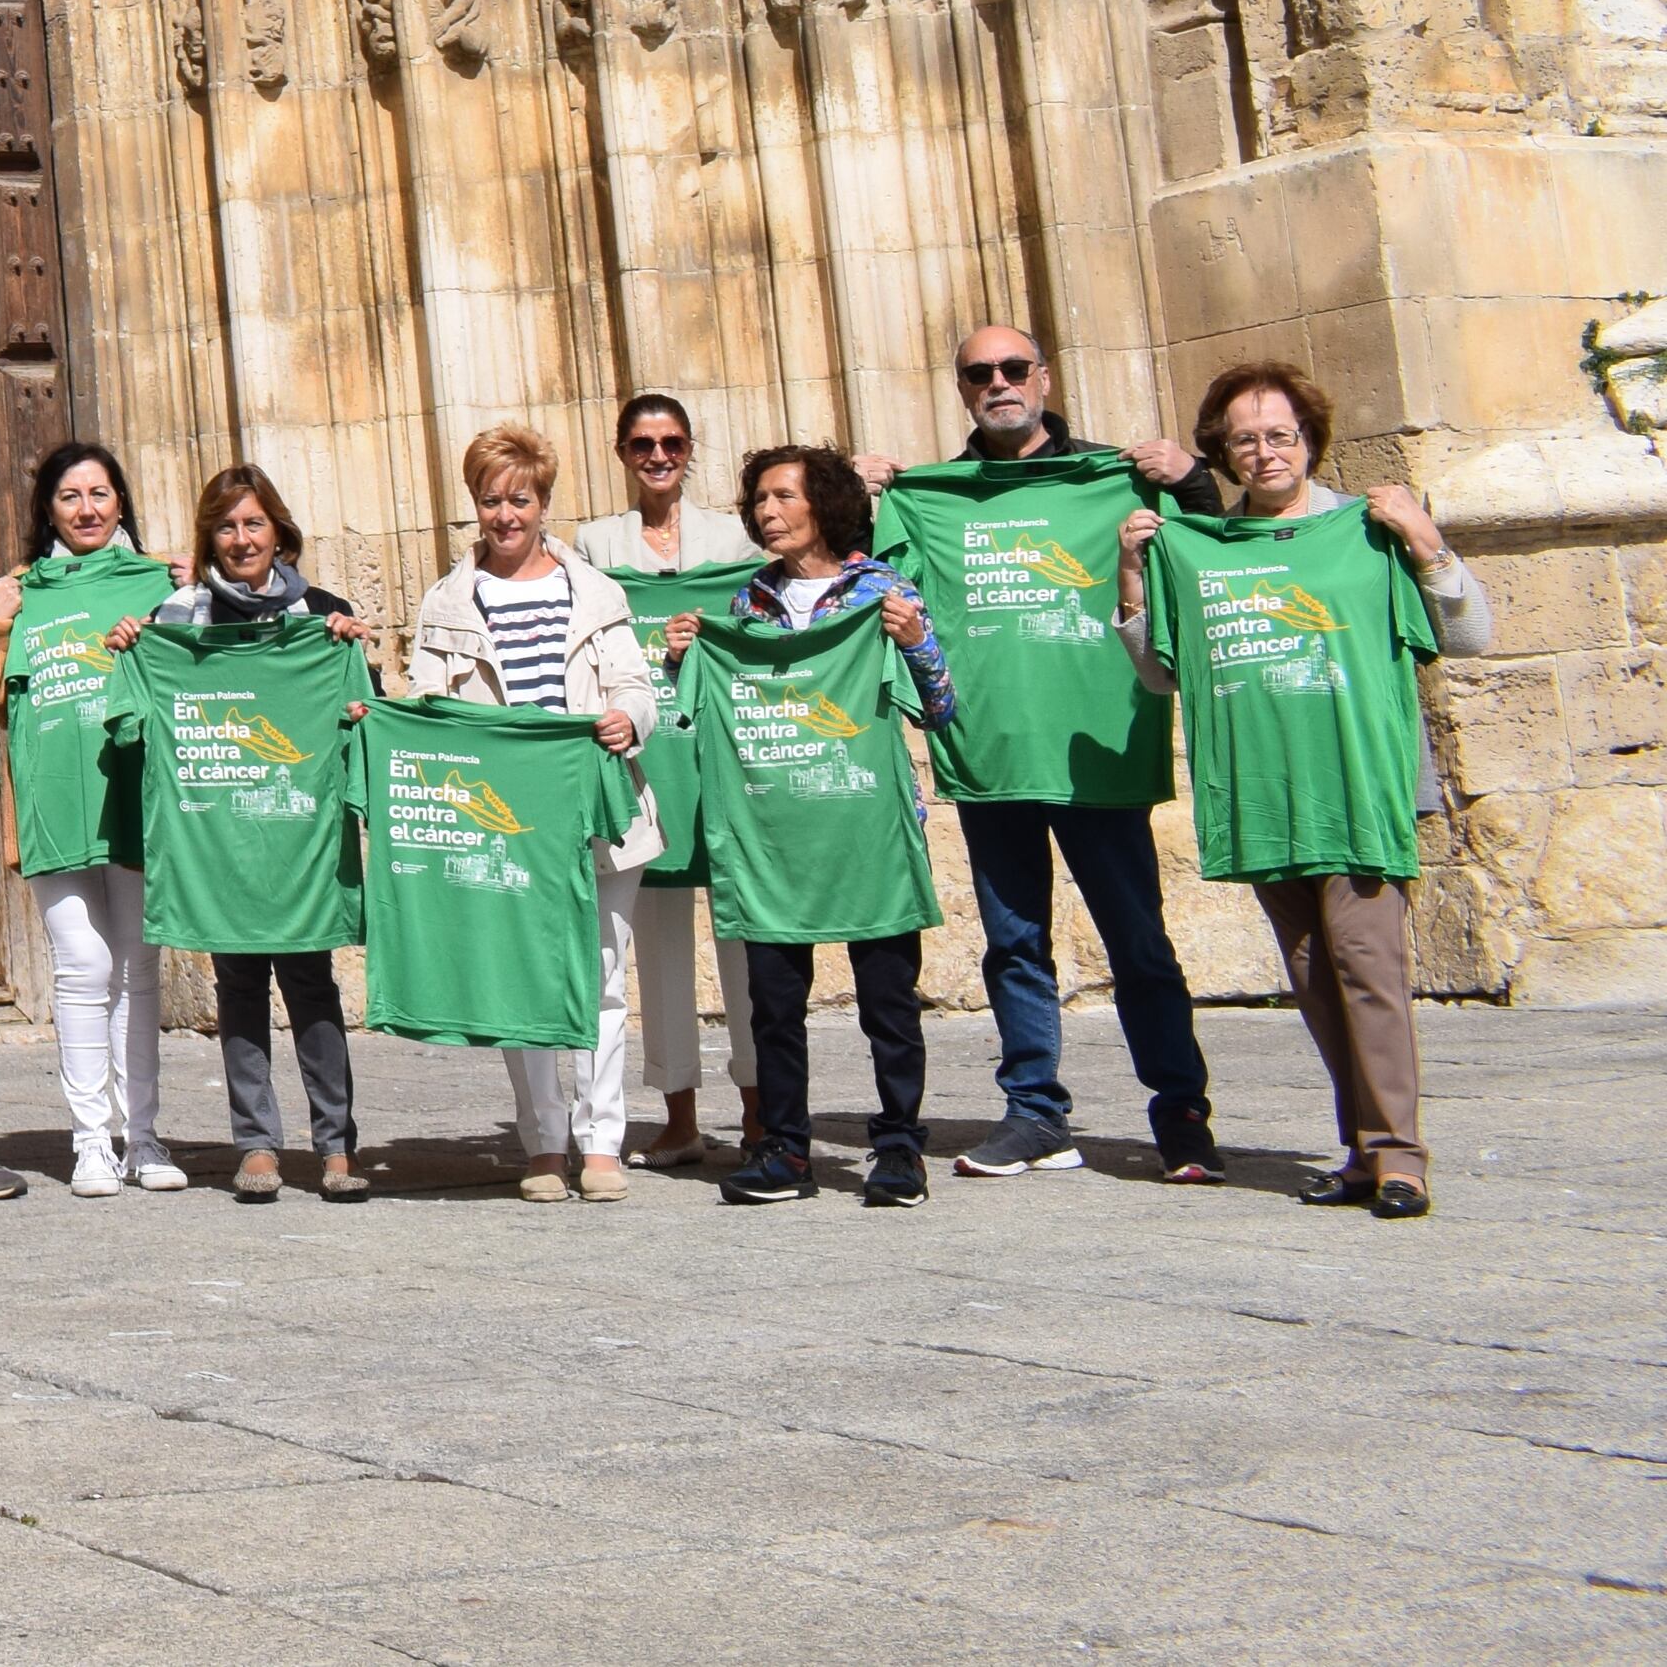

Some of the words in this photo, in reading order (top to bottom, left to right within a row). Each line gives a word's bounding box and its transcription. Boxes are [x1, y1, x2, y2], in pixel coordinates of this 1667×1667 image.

[1009, 518, 1049, 527] Palencia
[964, 532, 989, 547] En
[965, 547, 1041, 566] marcha
[965, 568, 1030, 585] contra
[1198, 570, 1206, 578] X
[1246, 565, 1289, 575] Palencia
[967, 588, 984, 605] el
[987, 586, 1059, 603] cáncer
[1199, 580, 1223, 597] En
[1203, 594, 1282, 619] marcha
[638, 615, 673, 624] Palenci
[1206, 617, 1271, 640] contra
[24, 635, 40, 653] En
[1211, 641, 1226, 661] el
[1228, 635, 1303, 657] cáncer
[43, 676, 106, 699] cáncer
[217, 691, 256, 699] Palencia
[732, 682, 757, 699] En
[174, 703, 199, 719] En
[734, 700, 809, 719] marcha
[175, 720, 251, 739] marcha
[735, 722, 798, 740] contra
[176, 743, 241, 759] contra
[400, 751, 436, 760] Carrera
[438, 753, 480, 763] Palencia
[738, 743, 755, 761] el
[759, 742, 826, 760] cáncer
[178, 763, 196, 779] el
[199, 763, 269, 779] cáncer
[390, 760, 416, 778] En
[390, 782, 470, 803] marcha
[389, 804, 457, 823] contra
[390, 823, 410, 840] el
[413, 825, 485, 845] cáncer
